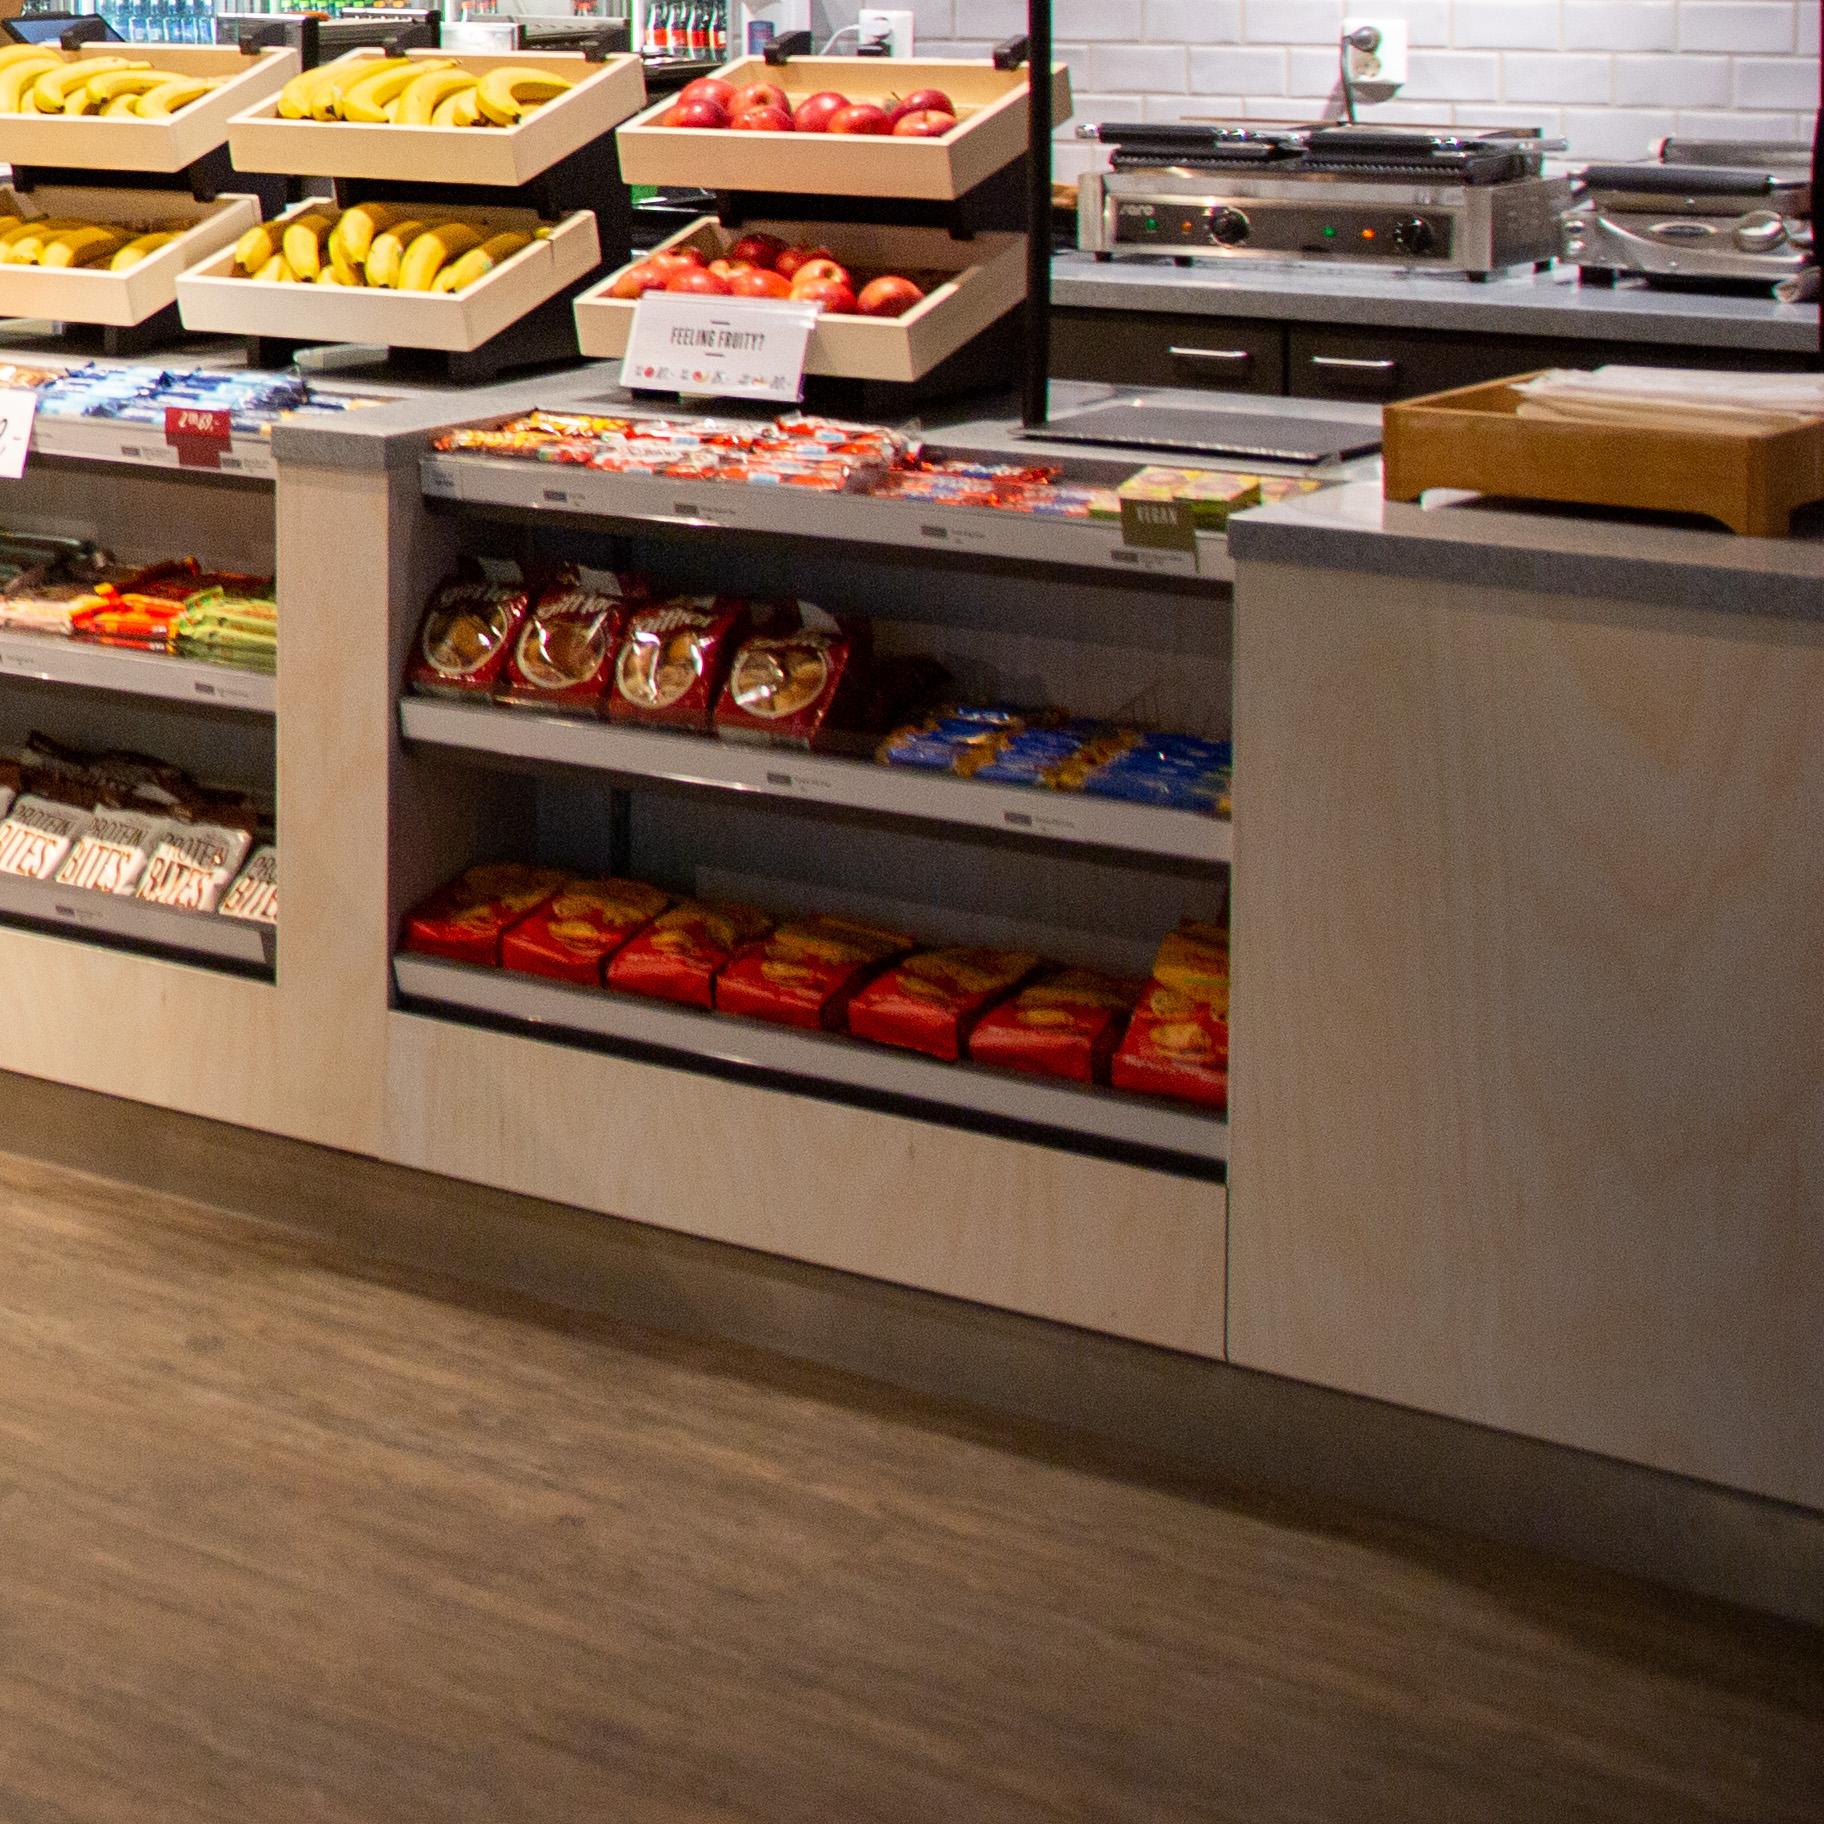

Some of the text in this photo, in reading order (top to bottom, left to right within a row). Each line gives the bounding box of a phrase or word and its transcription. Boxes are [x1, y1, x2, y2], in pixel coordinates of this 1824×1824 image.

[671, 327, 765, 352] FEELING FRUITY?
[59, 839, 133, 893] BITES
